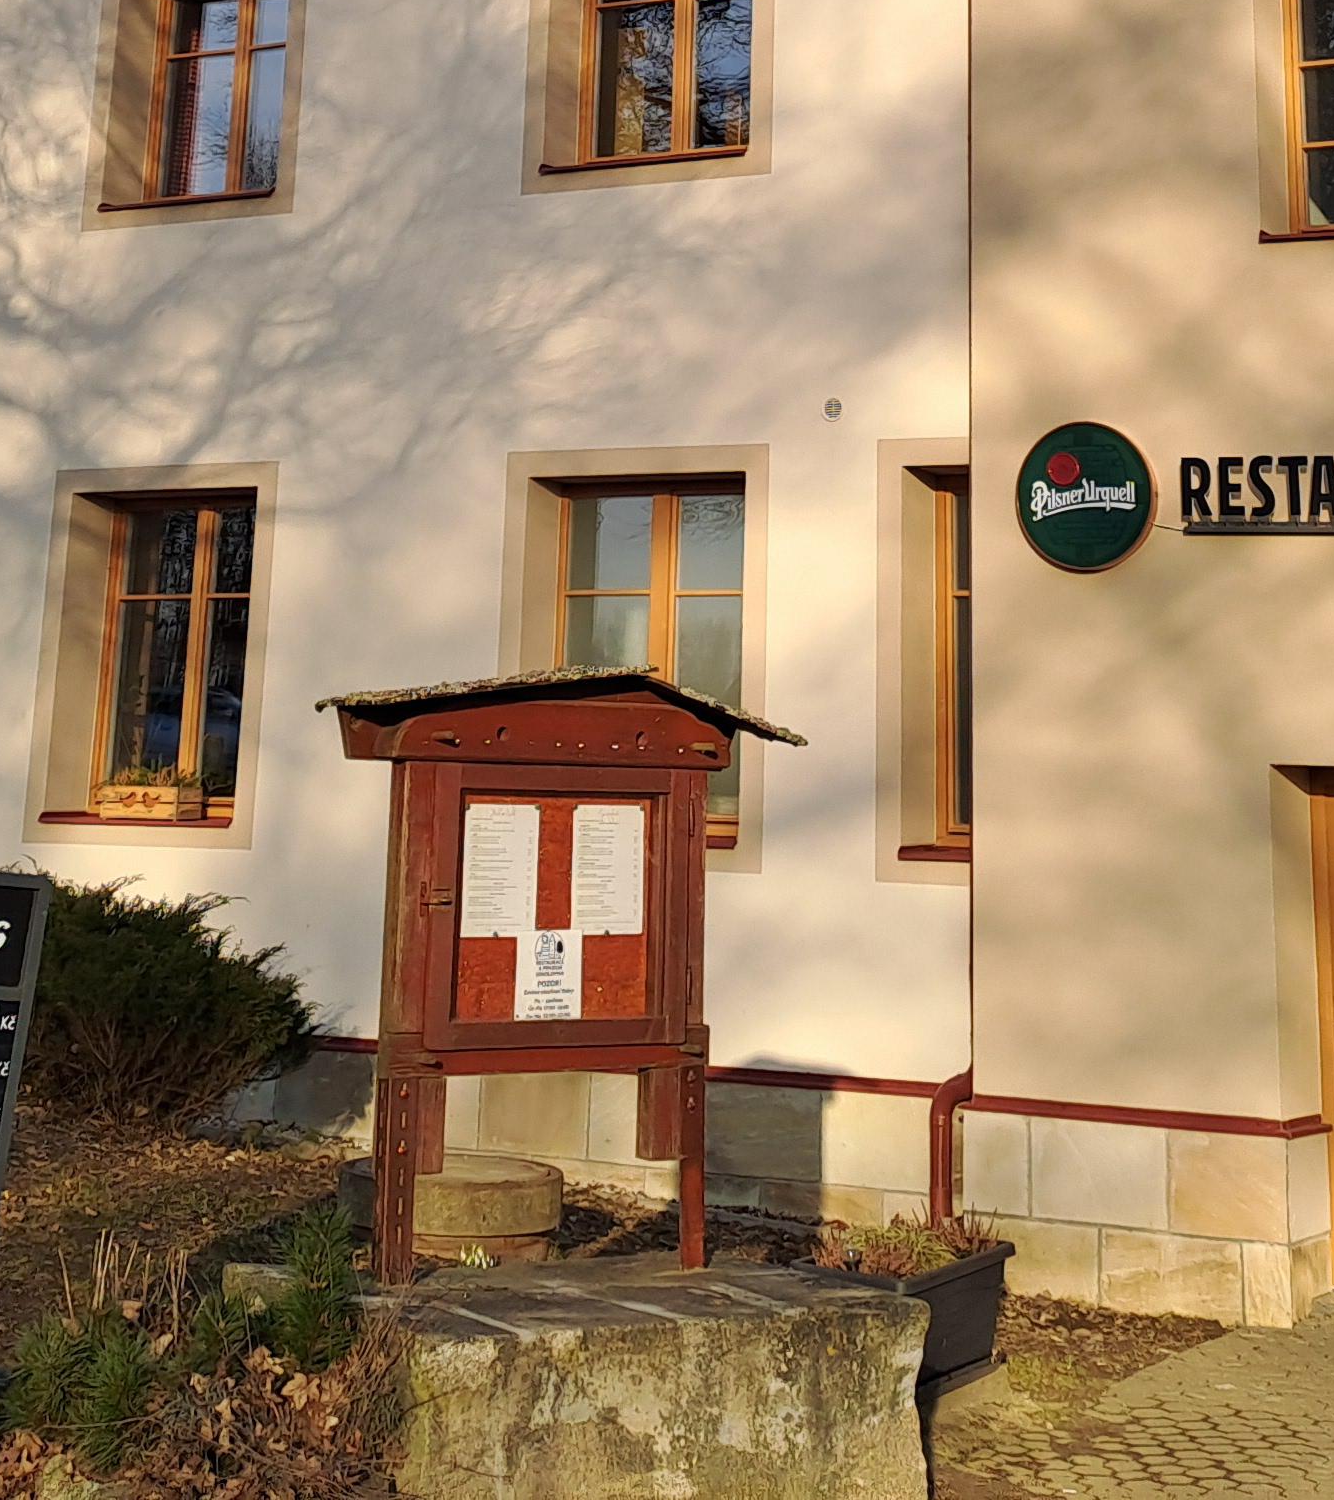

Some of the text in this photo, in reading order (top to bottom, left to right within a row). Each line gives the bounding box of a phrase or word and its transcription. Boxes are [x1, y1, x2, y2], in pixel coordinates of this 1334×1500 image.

[1030, 477, 1137, 522] Pilsner Urquell
[0, 1015, 17, 1031] Kč
